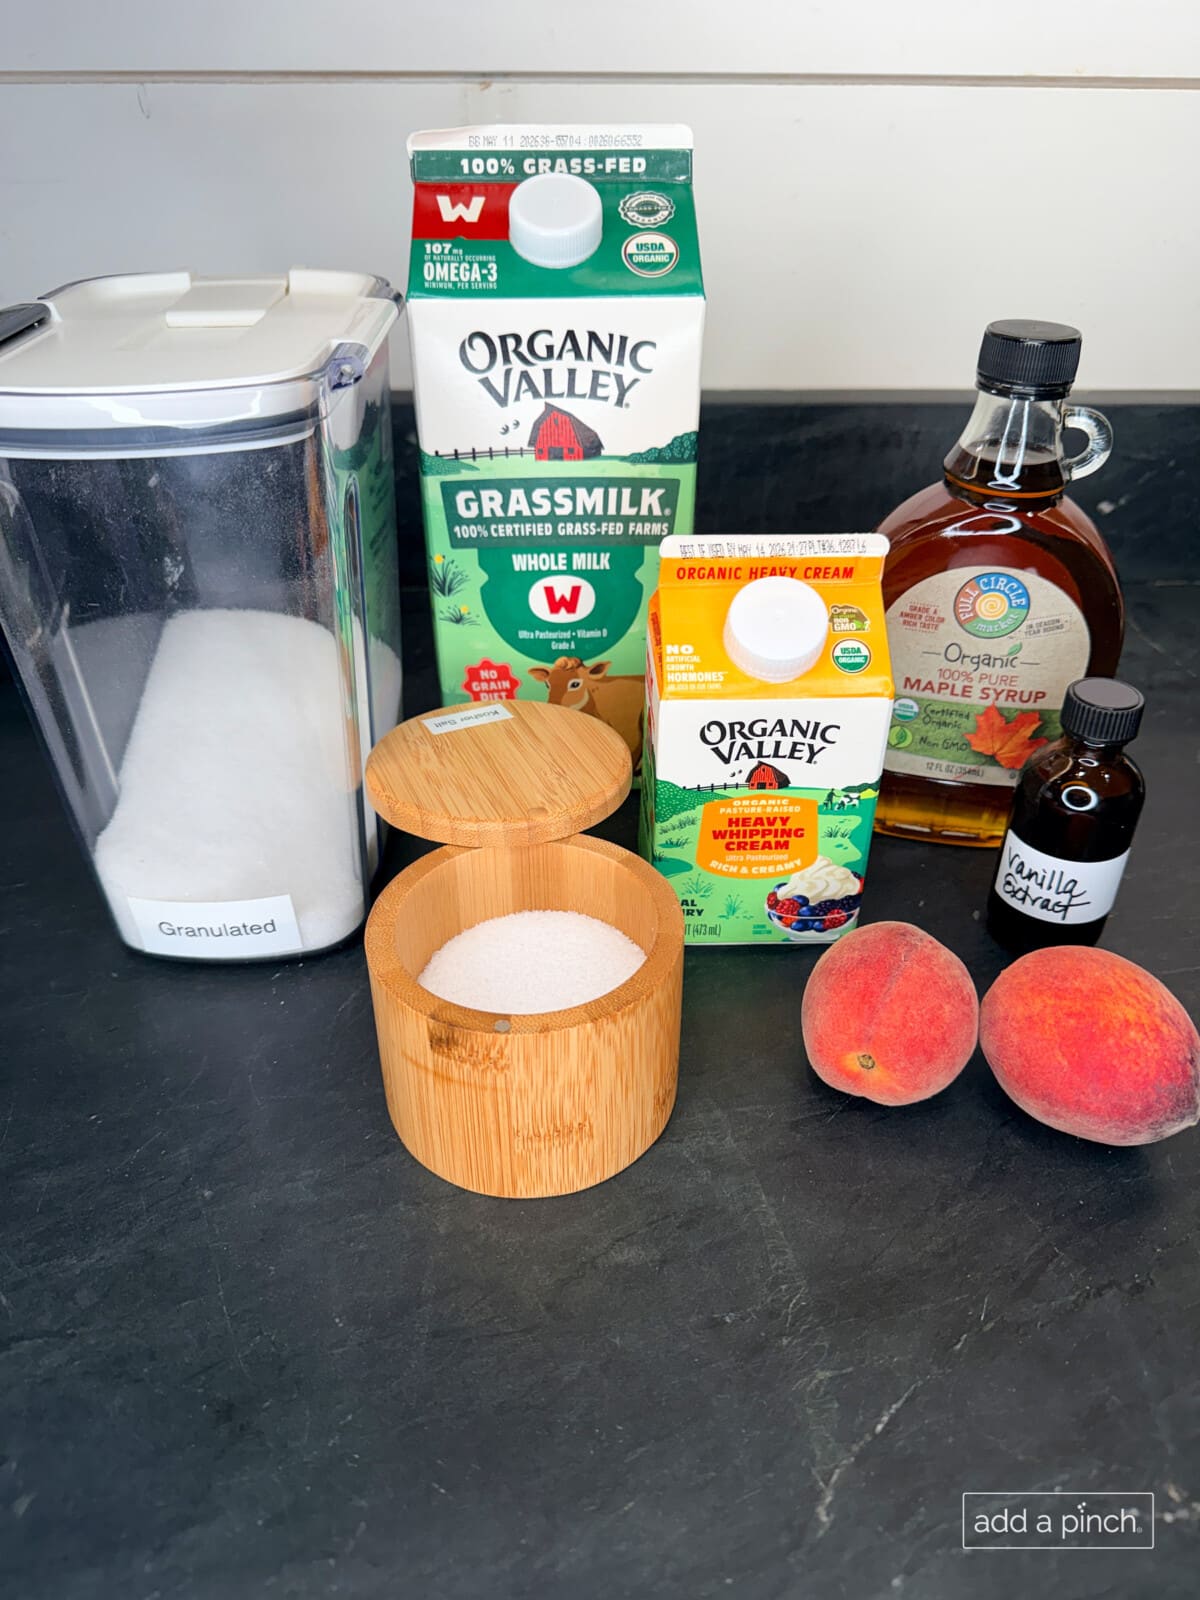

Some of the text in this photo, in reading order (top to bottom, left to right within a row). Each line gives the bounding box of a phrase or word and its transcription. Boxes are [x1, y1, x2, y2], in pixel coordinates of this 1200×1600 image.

[504, 135, 514, 146] 11
[460, 157, 647, 175] 100% GRASS-FED
[424, 243, 452, 254] 107
[635, 242, 666, 252] USDA
[632, 253, 670, 263] ORGANIC
[423, 262, 498, 282] OMEGA-3
[471, 282, 497, 290] SERVING
[459, 329, 657, 374] ORGANIC
[478, 367, 640, 408] VALLEY
[455, 487, 667, 519] GRASSMILK
[453, 521, 669, 539] 100% CERTIFIED GRASS-FED FARMS
[512, 552, 610, 571] WHOLE MILK
[676, 567, 854, 580] ORGANIC HEAVY CREAM
[544, 585, 582, 614] W
[959, 576, 1026, 620] FULL CIRCLE
[909, 604, 930, 613] GRADE
[900, 611, 922, 620] AMBER
[834, 622, 856, 631] GMO
[920, 622, 939, 631] TASTE
[518, 628, 608, 639] Ultra Pasteurized Vitamin D
[551, 641, 576, 650] Grade A
[666, 645, 694, 655] NO
[666, 655, 701, 663] ARTIFICIAL
[944, 643, 1019, 672] Organic
[480, 669, 497, 680] NO
[667, 672, 724, 682] HORMONES
[938, 668, 1019, 687] 100% PURE
[472, 680, 510, 691] GRAIN
[903, 677, 1047, 704] MAPLE SYRUP
[479, 691, 507, 700] DIET
[924, 703, 970, 720] Certified
[922, 714, 962, 730] Organic
[700, 719, 840, 745] ORGANIC
[919, 736, 969, 752] Non GMO
[711, 741, 826, 764] VALLEY
[926, 761, 934, 770] 12
[935, 763, 943, 772] FL
[945, 764, 954, 773] OZ
[733, 798, 789, 806] ORGANIC
[727, 816, 790, 828] HEAVY
[712, 828, 805, 840] WHIPPING
[725, 840, 789, 851] CREAM
[709, 860, 738, 873] RICH
[751, 858, 801, 874] CREAMY
[158, 918, 277, 938] Granulated
[692, 924, 707, 937] (473
